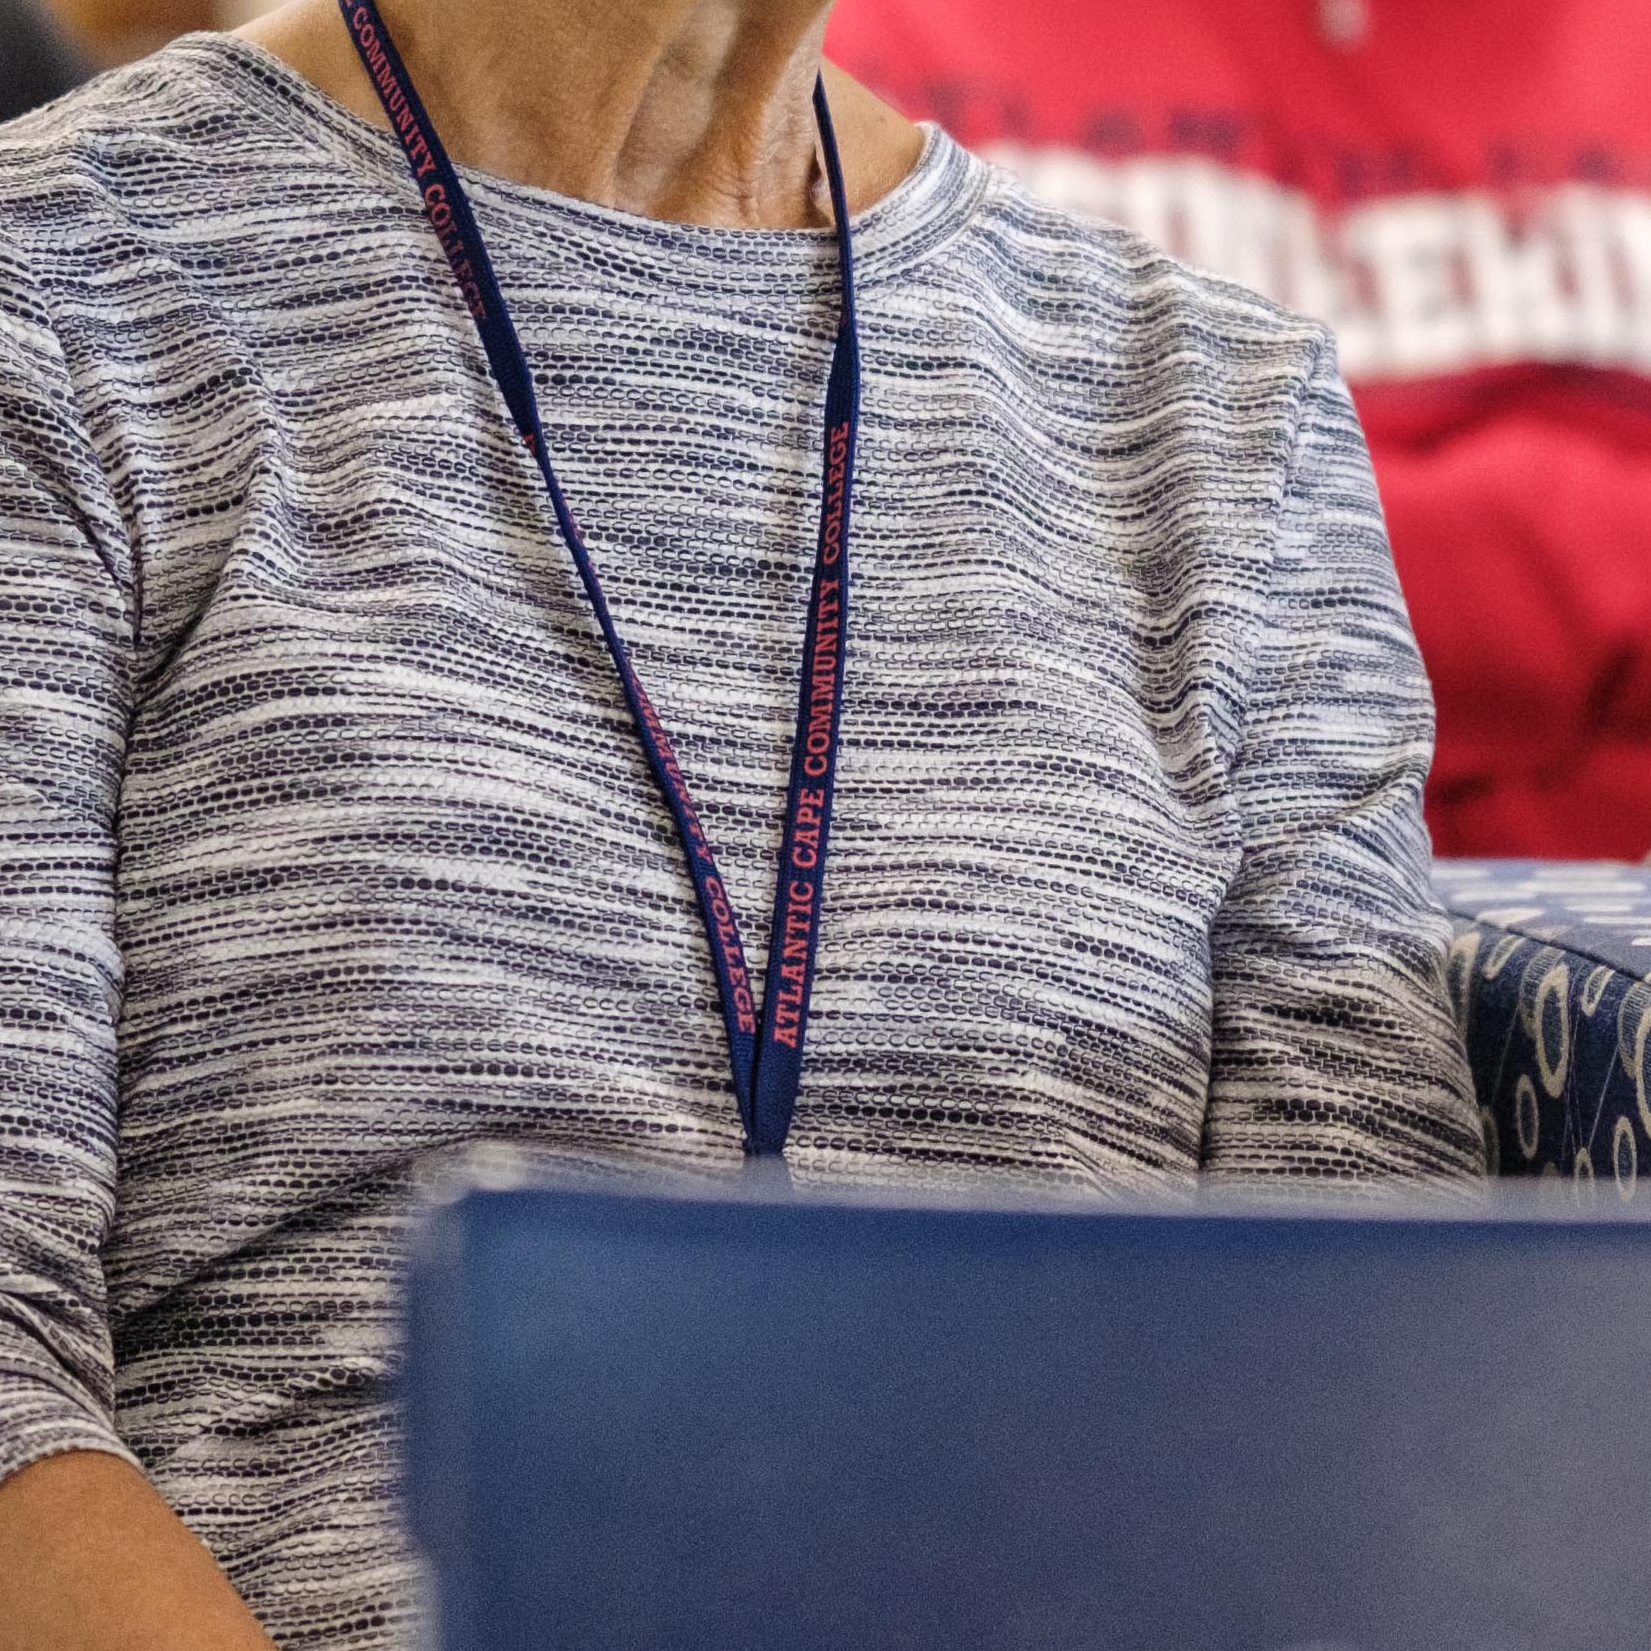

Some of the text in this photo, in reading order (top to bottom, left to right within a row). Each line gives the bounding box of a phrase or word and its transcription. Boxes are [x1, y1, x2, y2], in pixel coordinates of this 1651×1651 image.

[353, 6, 434, 177] COMMUNITY
[424, 183, 487, 320] COLLEGE
[773, 420, 849, 1048] ATLANTIC CAPE COMMUNITY COLLEGE
[705, 876, 757, 1035] COLLEGE
